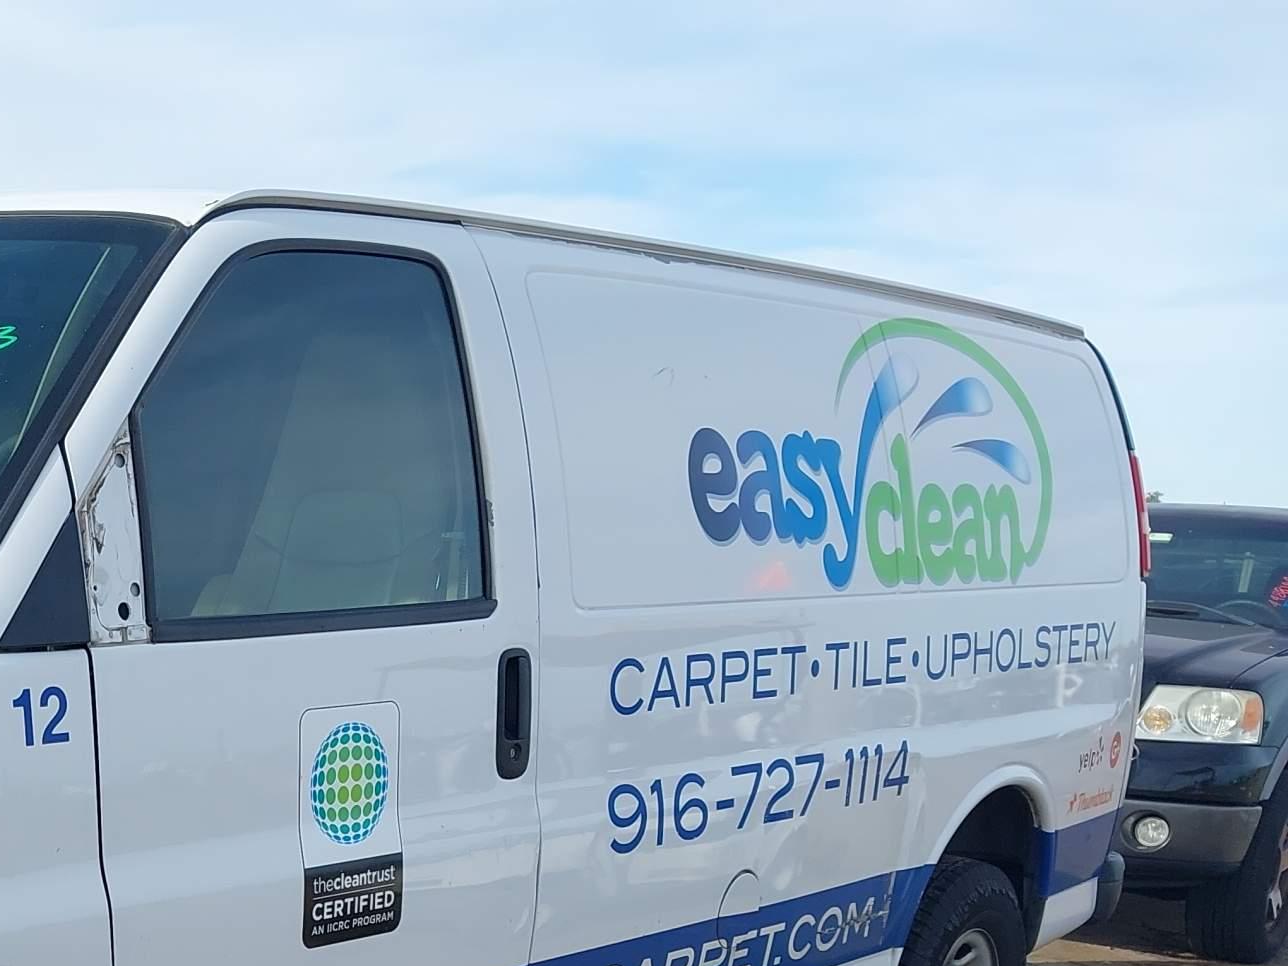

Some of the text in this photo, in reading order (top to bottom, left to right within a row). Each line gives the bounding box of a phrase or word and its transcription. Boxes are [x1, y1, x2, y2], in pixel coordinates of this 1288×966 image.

[688, 370, 1027, 590] easy clean
[610, 621, 1116, 716] CARPET TILE UPHOLSTERY
[12, 686, 70, 747] 12
[607, 740, 910, 854] 916-727-1114
[312, 890, 395, 921] CERTIFIED
[313, 865, 396, 894] thecleantrust
[311, 924, 325, 936] AN
[352, 910, 394, 928] PROGRAM
